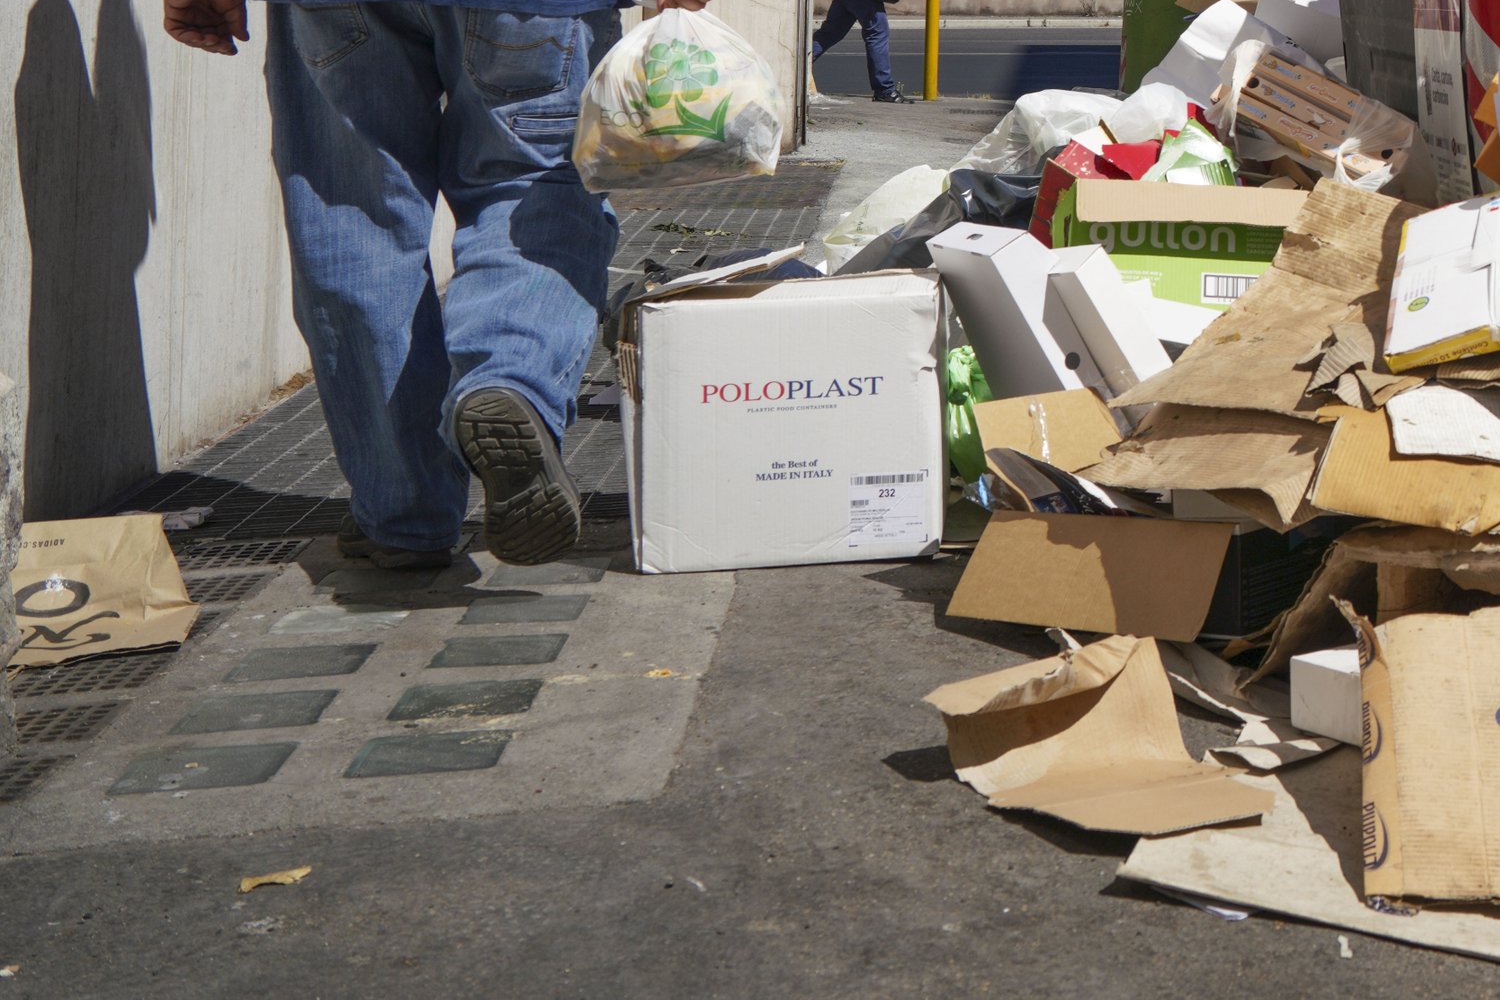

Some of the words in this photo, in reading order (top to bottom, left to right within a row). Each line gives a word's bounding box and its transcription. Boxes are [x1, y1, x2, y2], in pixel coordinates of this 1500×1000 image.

[600, 108, 644, 128] ECO
[701, 376, 884, 404] POLOPLAST
[796, 403, 838, 411] CONTAINERS
[771, 461, 786, 470] the
[787, 460, 807, 469] Best
[808, 459, 818, 468] of
[755, 471, 787, 482] MADE
[789, 471, 801, 480] IN
[803, 469, 834, 479] ITALY
[878, 488, 896, 498] 232
